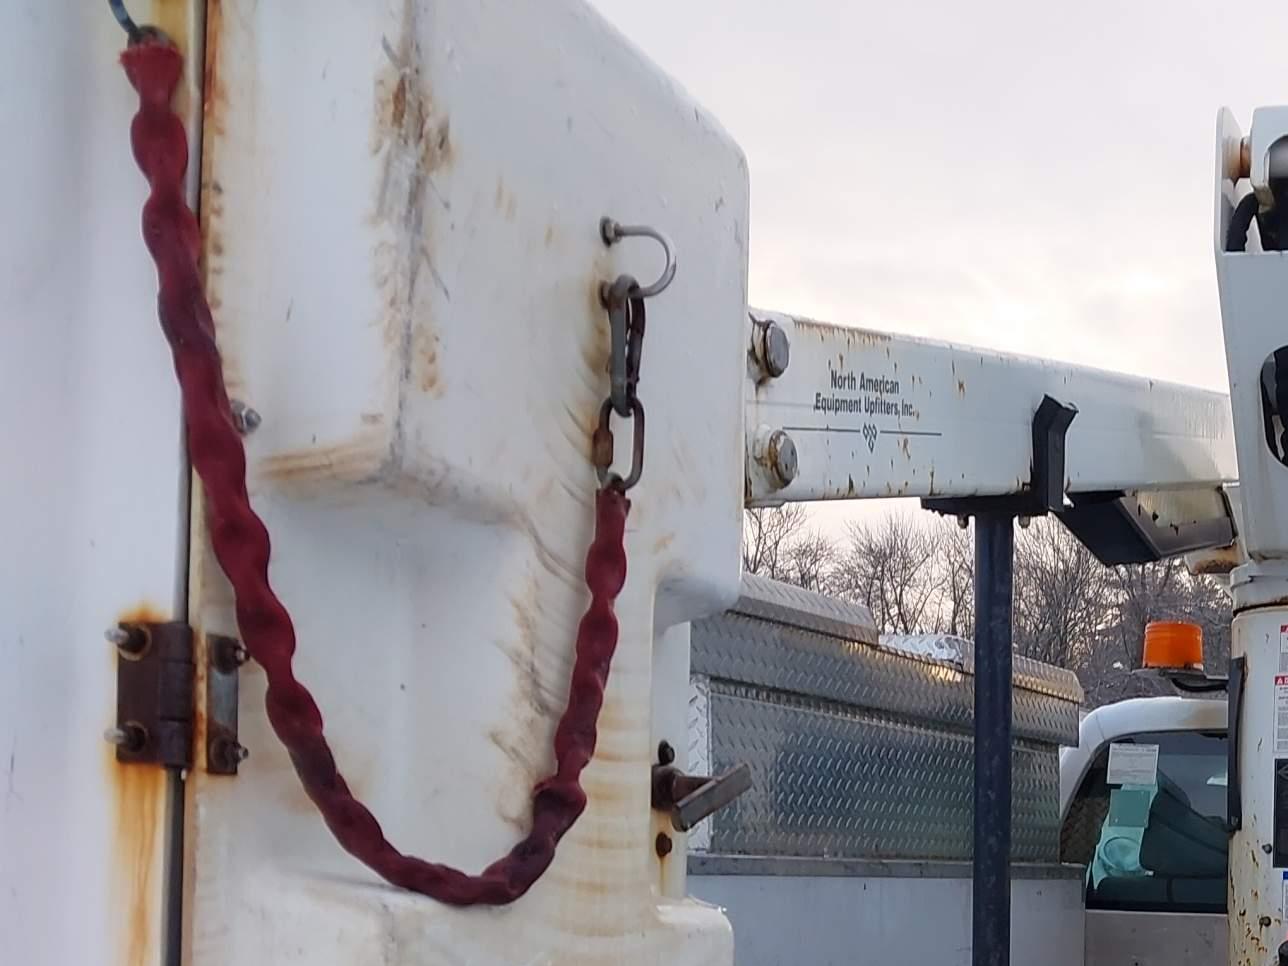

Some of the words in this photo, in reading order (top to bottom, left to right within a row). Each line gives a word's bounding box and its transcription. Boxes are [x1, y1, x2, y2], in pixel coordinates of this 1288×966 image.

[830, 369, 857, 391] North
[860, 371, 900, 394] American
[815, 392, 862, 416] Equipment
[901, 399, 915, 416] Inc.
